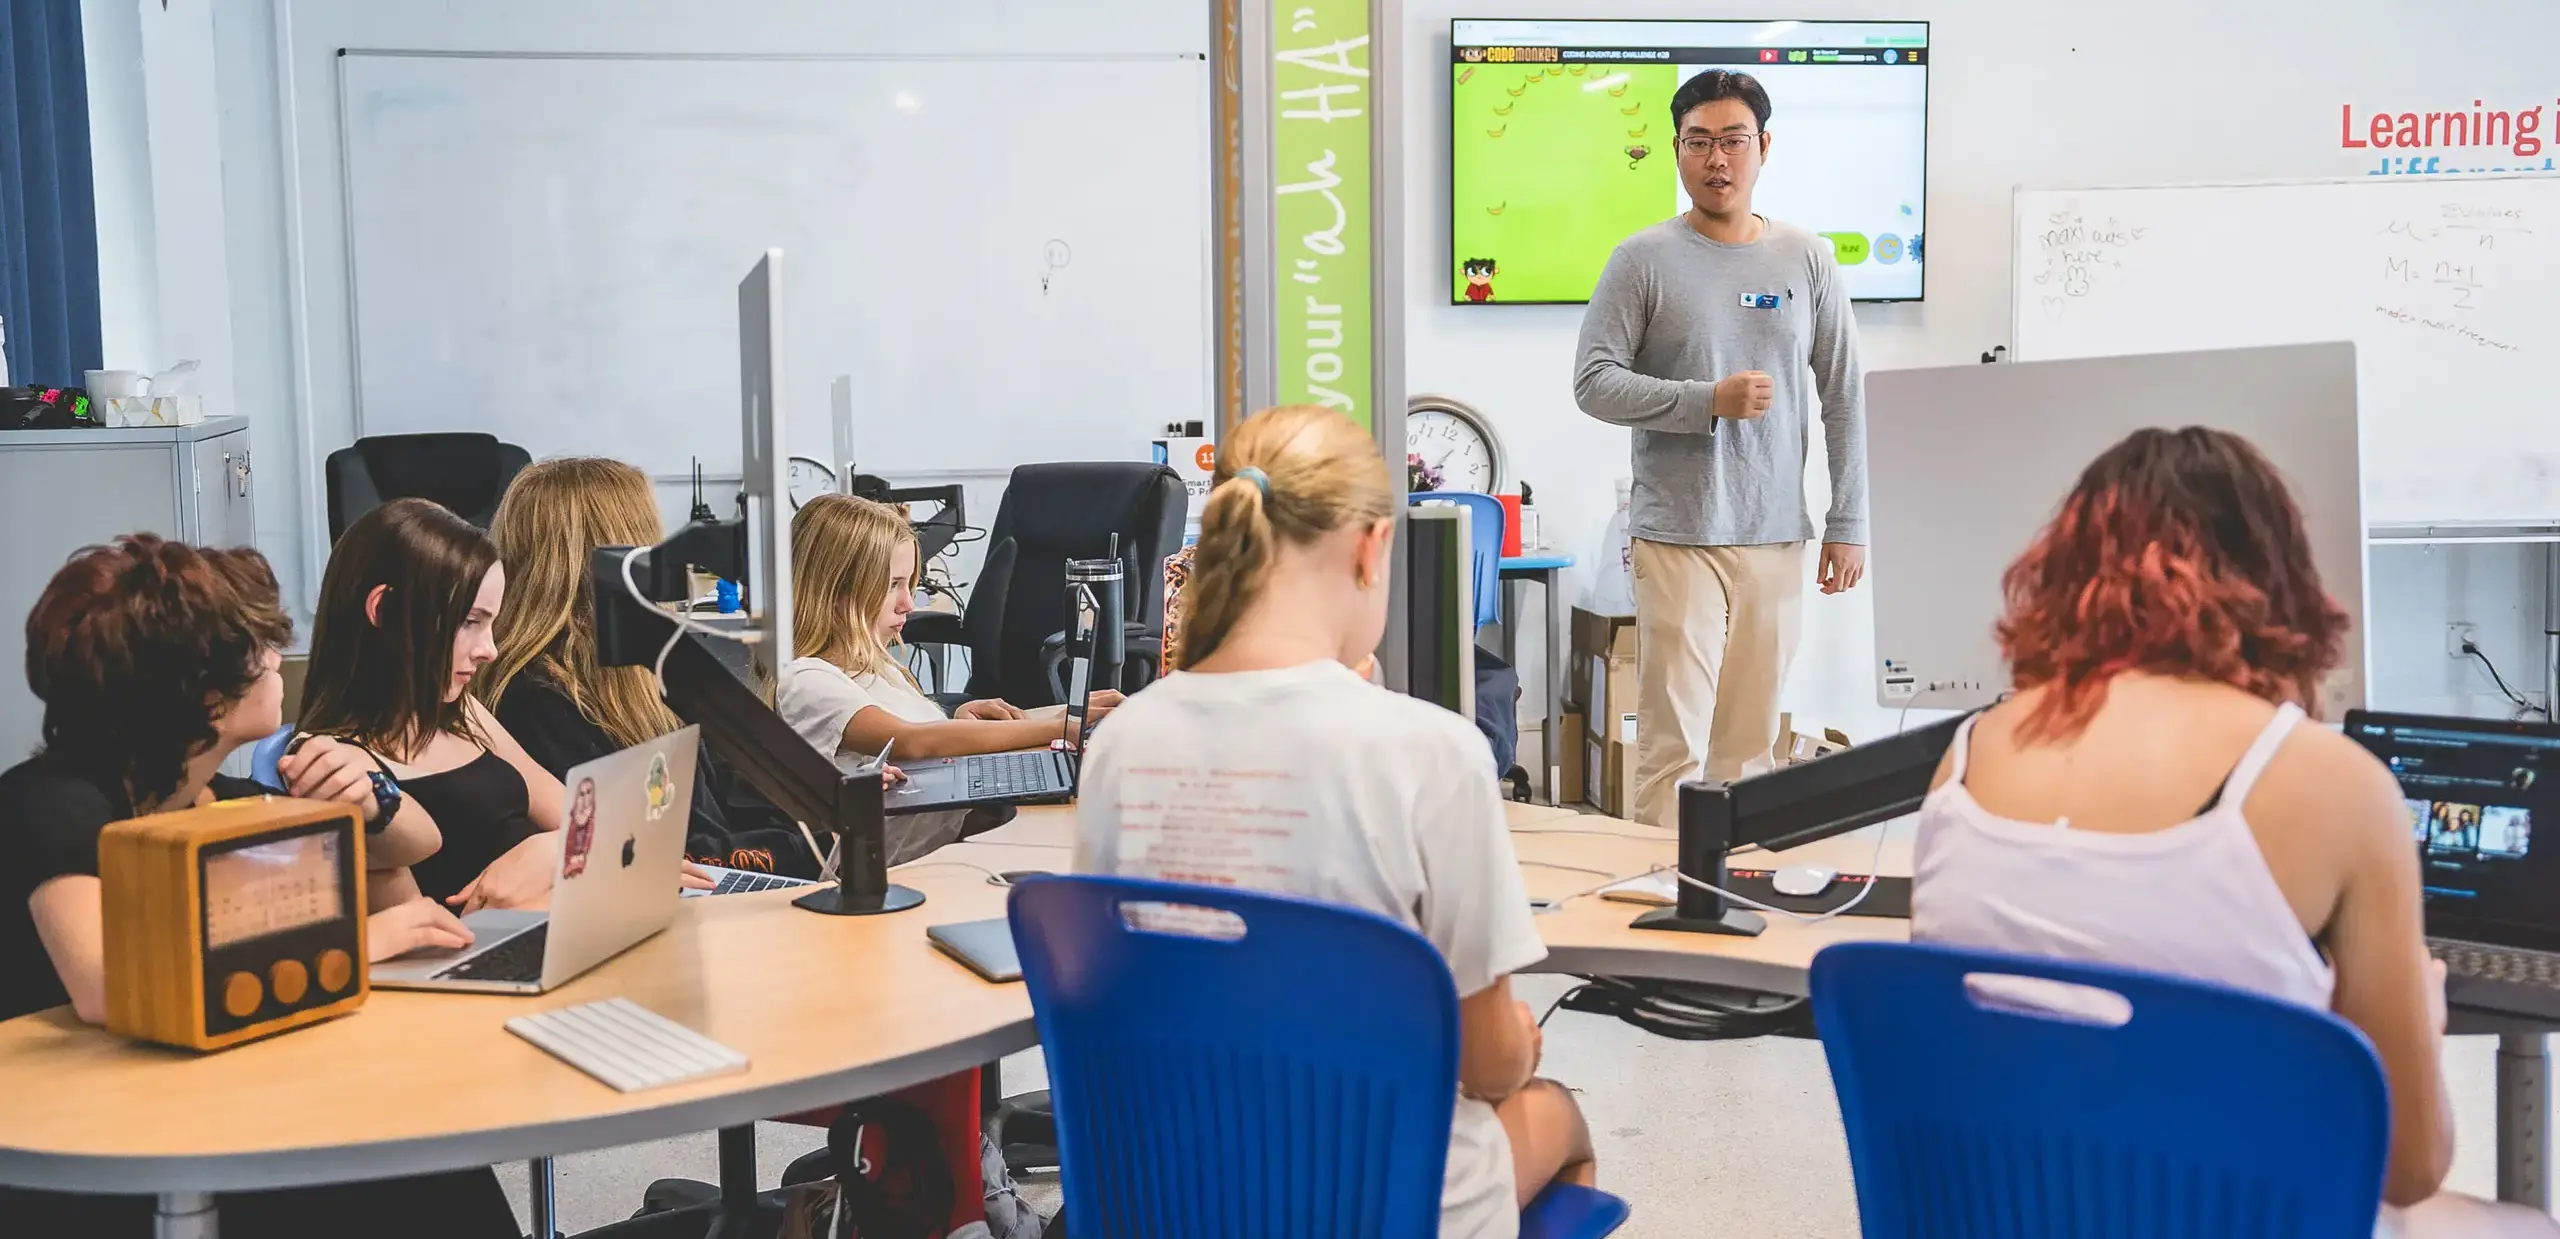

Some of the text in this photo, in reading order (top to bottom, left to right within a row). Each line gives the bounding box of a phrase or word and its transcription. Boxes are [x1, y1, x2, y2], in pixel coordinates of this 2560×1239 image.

[2341, 99, 2543, 157] Learning
[2479, 233, 2494, 251] n
[2452, 287, 2475, 310] 2
[1306, 296, 1353, 412] your
[1418, 422, 1434, 438] 11
[1441, 426, 1458, 441] 12
[1463, 444, 1472, 456] 1
[1468, 462, 1480, 475] 2
[820, 478, 830, 491] 2
[1184, 479, 1211, 487] mart
